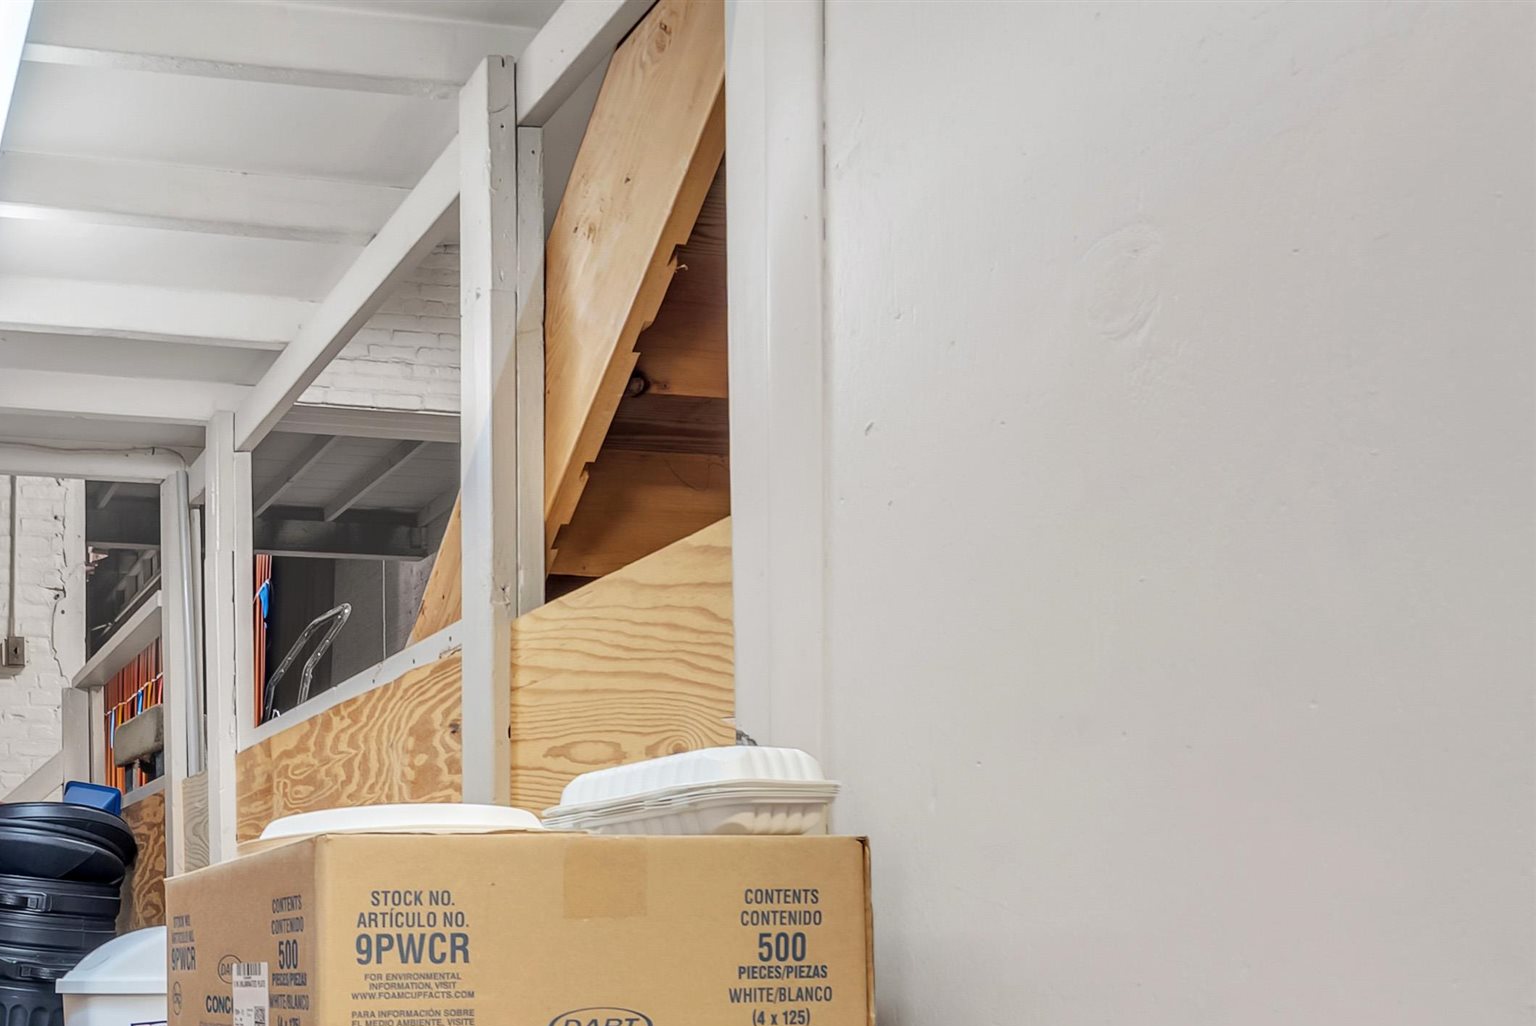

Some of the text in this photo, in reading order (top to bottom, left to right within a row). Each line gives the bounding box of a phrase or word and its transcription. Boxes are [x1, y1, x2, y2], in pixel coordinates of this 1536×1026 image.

[272, 894, 302, 914] CONTENTS
[371, 890, 455, 906] STOCK NO.
[744, 889, 819, 904] CONTENTS
[356, 908, 470, 928] ARTÍCULO NO.
[740, 910, 822, 926] CONTENIDO
[278, 939, 298, 969] 500
[355, 932, 470, 965] 9PWCR
[758, 932, 807, 962] 500
[364, 972, 462, 981] FOR ENVIRONMENTAL
[738, 965, 828, 980] PIECES/PIEZAS
[369, 981, 457, 991] INFORMATION, VISIT
[351, 991, 475, 1000] WWW.FOAMCUPFACTS.COM
[729, 986, 833, 1004] WHITE/BLANCO
[351, 1008, 475, 1018] PARA INFORMACIÓN SOBRE
[752, 1007, 811, 1026] (4 x 125)
[447, 1018, 475, 1026] VISITE
